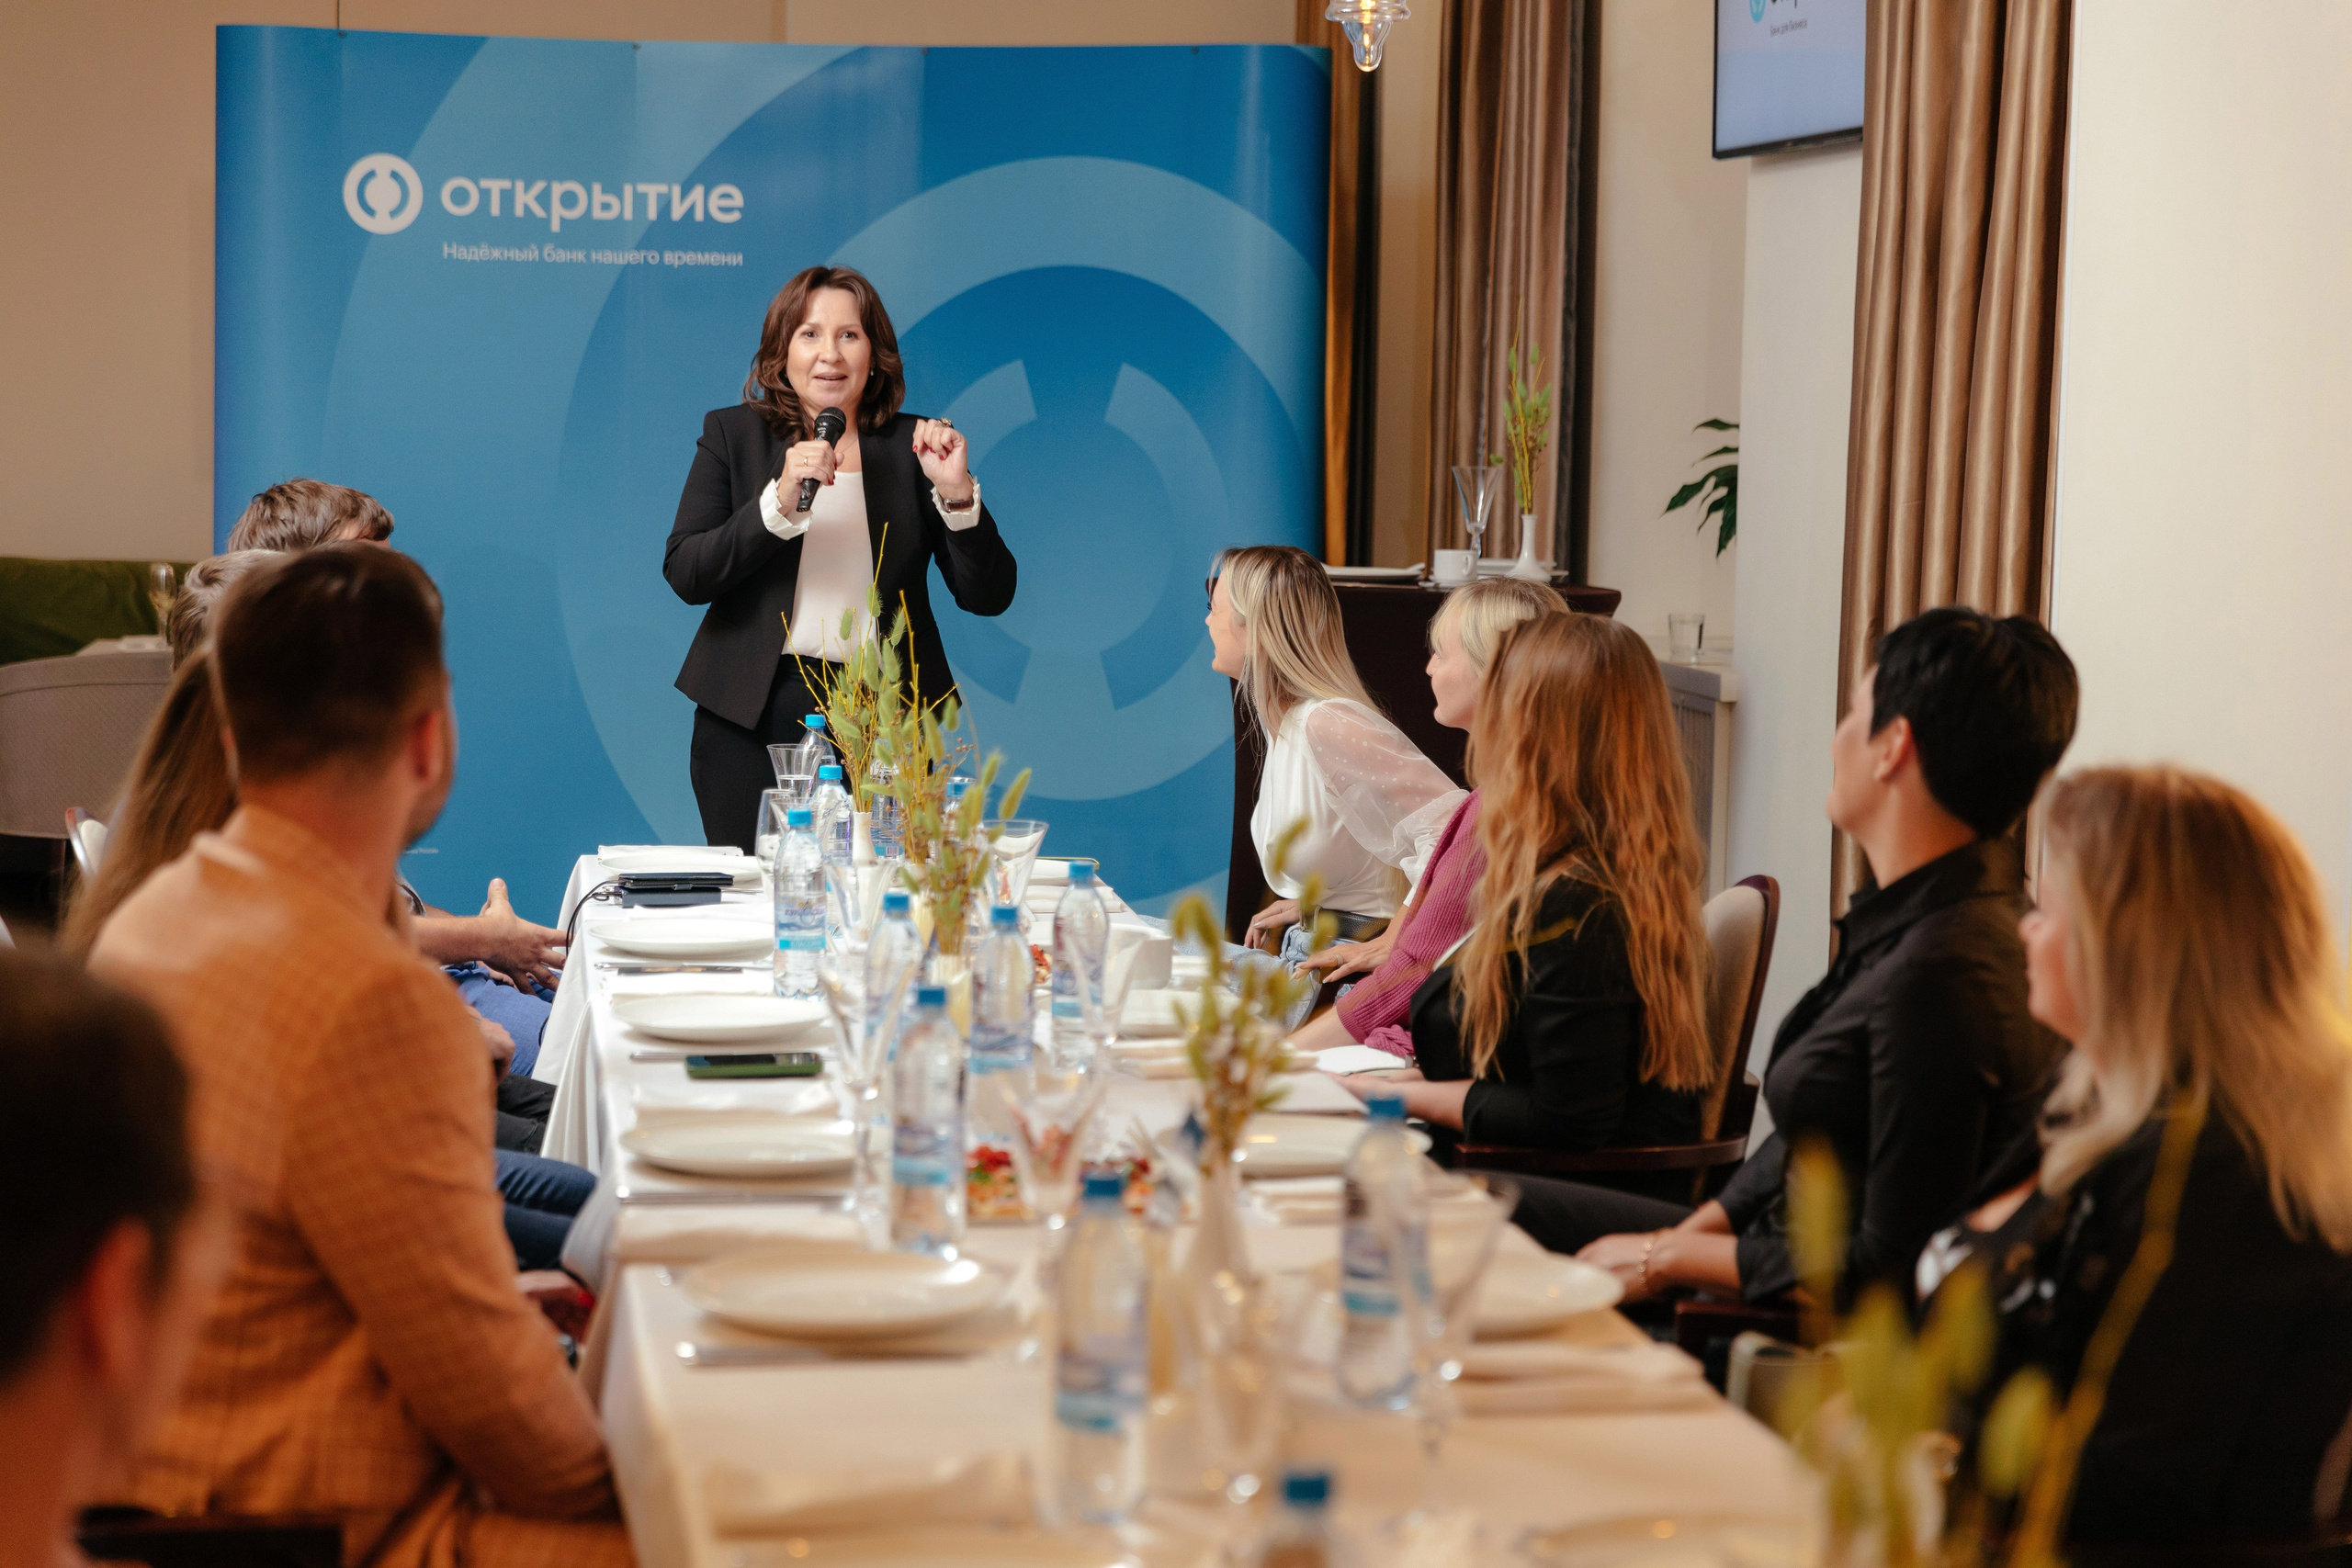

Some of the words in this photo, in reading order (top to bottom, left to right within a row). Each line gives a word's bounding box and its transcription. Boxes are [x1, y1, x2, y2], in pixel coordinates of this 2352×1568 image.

[443, 242, 539, 263] Надёжный
[544, 243, 586, 263] банк
[591, 249, 660, 265] нашего
[662, 250, 743, 269] времени
